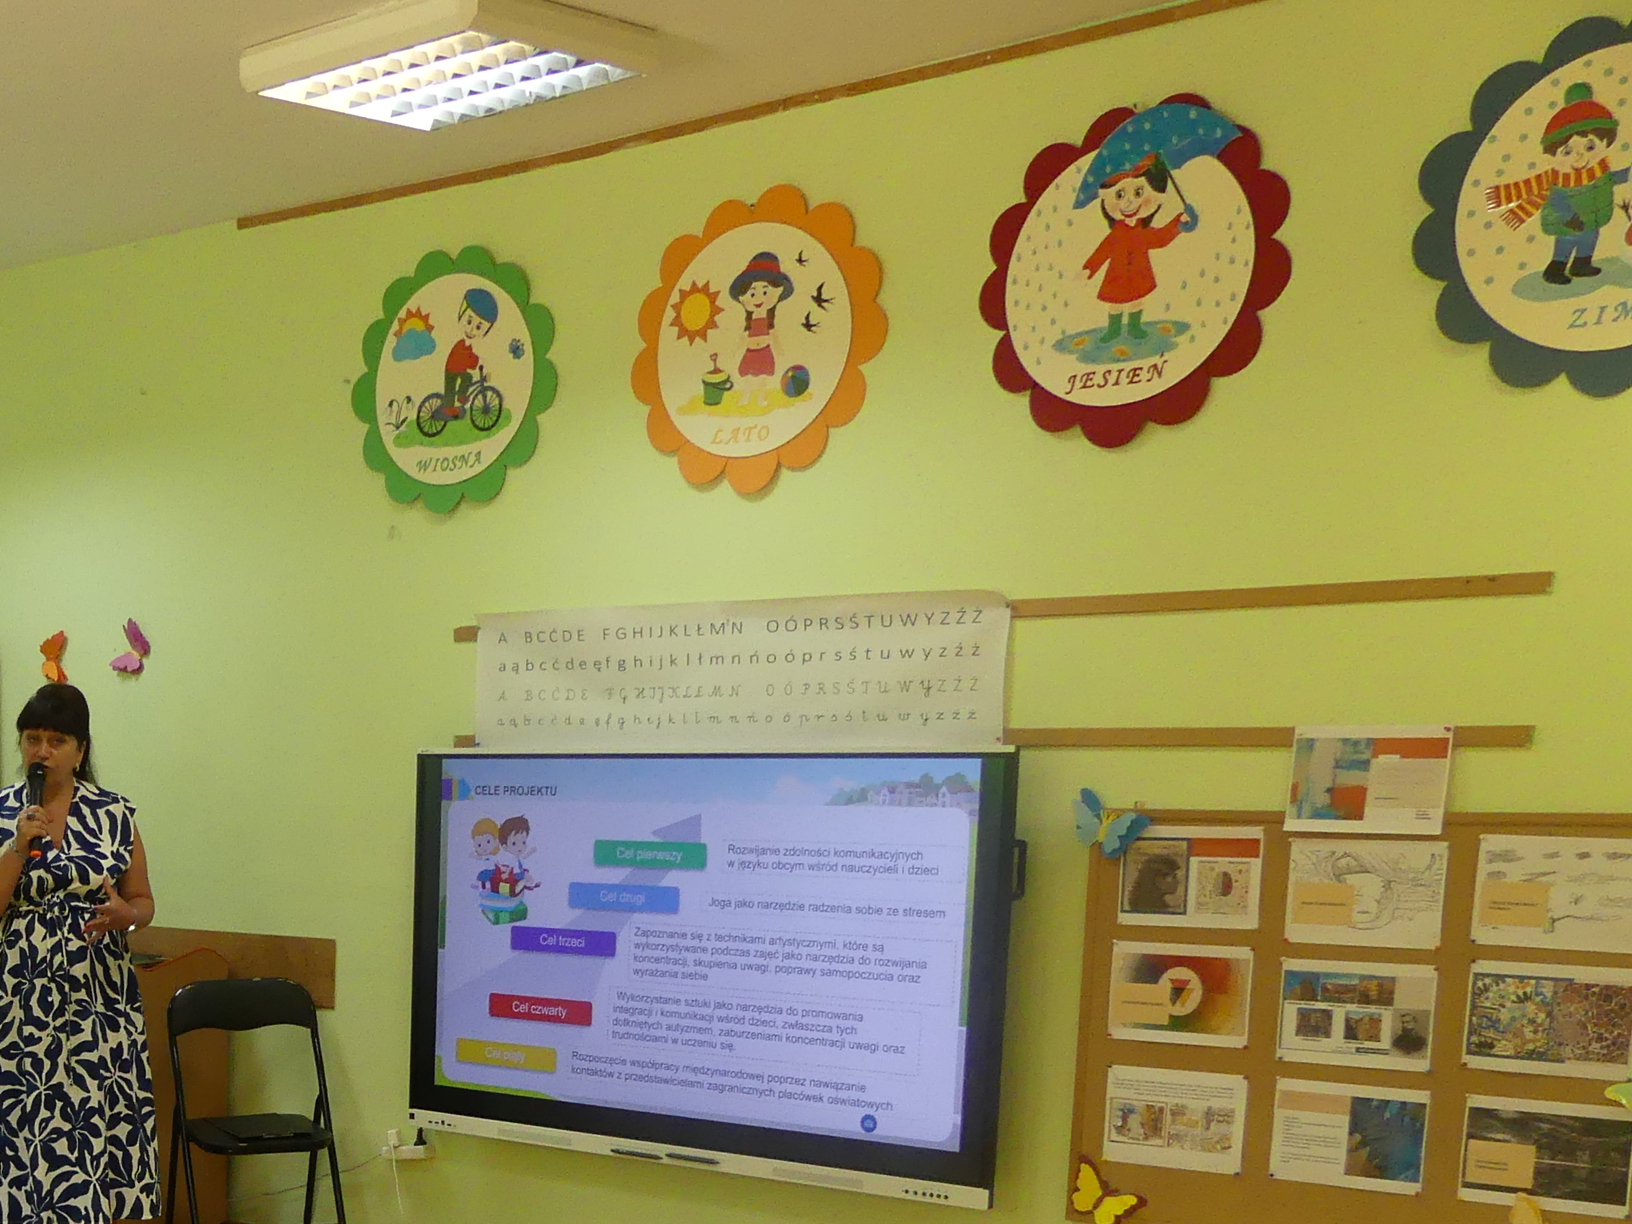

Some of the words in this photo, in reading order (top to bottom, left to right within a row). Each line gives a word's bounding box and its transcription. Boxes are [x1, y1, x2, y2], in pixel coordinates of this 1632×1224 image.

[1065, 351, 1168, 395] JESIEŃ
[711, 424, 770, 445] LATO
[415, 449, 481, 474] WIOSNA
[475, 785, 500, 796] CELE
[503, 785, 557, 797] PROJEKTU
[616, 847, 634, 859] Cel
[635, 849, 684, 864] pierwszy
[727, 843, 781, 858] Rozwijanie
[783, 845, 831, 858] zdolności
[833, 847, 924, 862] komunikacyjnych
[726, 860, 735, 868] w
[737, 859, 769, 872] języku
[771, 862, 805, 873] obcym
[807, 861, 838, 873] wśród
[841, 863, 899, 876] nauczycieli
[908, 864, 940, 876] dzieci
[708, 896, 732, 910] Joga
[734, 897, 755, 910] jako
[757, 899, 805, 913] narzędzie
[808, 902, 852, 915] radzenia
[855, 904, 883, 916] sobie
[886, 907, 899, 917] ze
[902, 906, 946, 919] stresem
[539, 934, 556, 946] Cel
[558, 935, 585, 947] trzeci
[633, 927, 687, 943] Zapoznanie
[690, 931, 703, 943] się
[714, 932, 766, 945] technikami
[842, 940, 868, 951] które
[872, 943, 885, 954] są
[633, 941, 708, 954] wykorzystywane
[710, 946, 750, 958] podczas
[753, 948, 779, 961] zajęć
[781, 950, 802, 962] jako
[805, 953, 854, 966] narzędzia
[858, 954, 871, 966] do
[874, 957, 927, 970] rozwijania
[633, 967, 678, 979] wyrażania
[680, 970, 709, 981] siebie
[693, 957, 737, 970] skupienia
[774, 964, 817, 978] poprawy
[819, 966, 894, 981] samopoczucia
[897, 973, 921, 984] oraz
[512, 1000, 528, 1013] Cel
[530, 1004, 567, 1018] czwarty
[617, 990, 682, 1006] Wykorzystanie
[684, 997, 711, 1009] sztuki
[712, 999, 733, 1011] jako
[735, 1002, 783, 1016] narzędzia
[786, 1005, 799, 1017] do
[801, 1008, 864, 1022] promowania
[612, 1005, 653, 1019] integracji
[660, 1008, 714, 1024] komunikacji
[717, 1013, 745, 1025] wśród
[781, 1020, 833, 1034] zwłaszcza
[836, 1025, 857, 1037] tych
[611, 1030, 669, 1044] trudnościami
[681, 1037, 717, 1049] uczeniu
[612, 1017, 663, 1032] dotkniętych
[718, 1027, 783, 1042] zaburzeniami
[785, 1033, 846, 1050] koncentracji
[848, 1041, 879, 1054] uwagi
[882, 1044, 906, 1054] oraz
[571, 1051, 627, 1067] Rozpoczęcie
[629, 1058, 680, 1073] współpracy
[682, 1063, 765, 1083] międzynarodowej
[767, 1074, 807, 1086] poprzez
[809, 1078, 866, 1093] nawiązanie
[571, 1064, 614, 1078] kontaktów
[624, 1073, 704, 1089] przedstawicielami
[707, 1081, 775, 1098] zagranicznych
[778, 1089, 825, 1104] placówek
[827, 1094, 893, 1112] oświatowych
